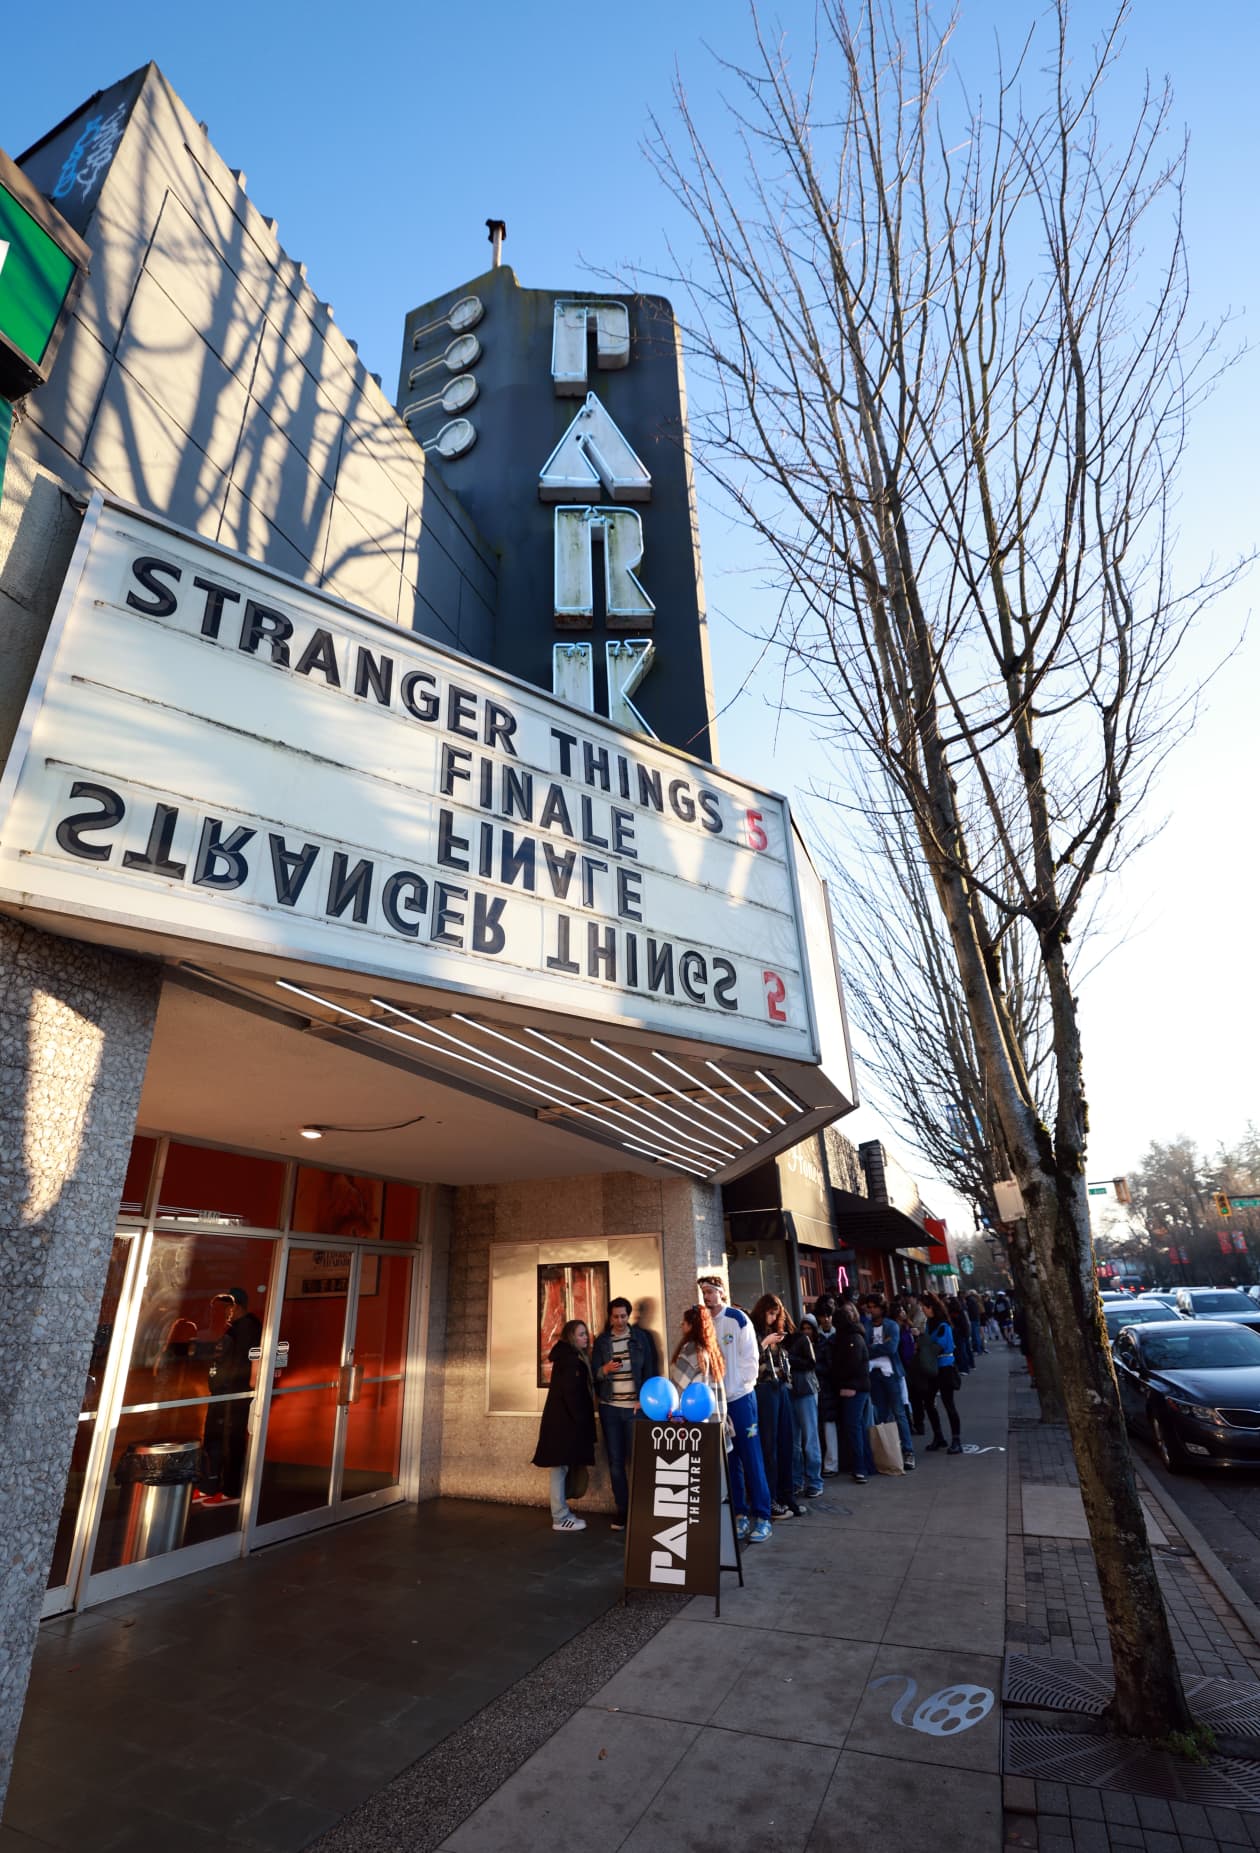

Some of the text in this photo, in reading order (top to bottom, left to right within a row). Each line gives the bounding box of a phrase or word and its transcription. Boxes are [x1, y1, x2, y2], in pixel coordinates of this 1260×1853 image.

[538, 299, 656, 743] PARK
[125, 556, 768, 852] STRANGER THINGS 5
[440, 741, 638, 859] FINALE
[650, 1452, 690, 1586] PARK
[690, 1456, 702, 1525] THEATRE
